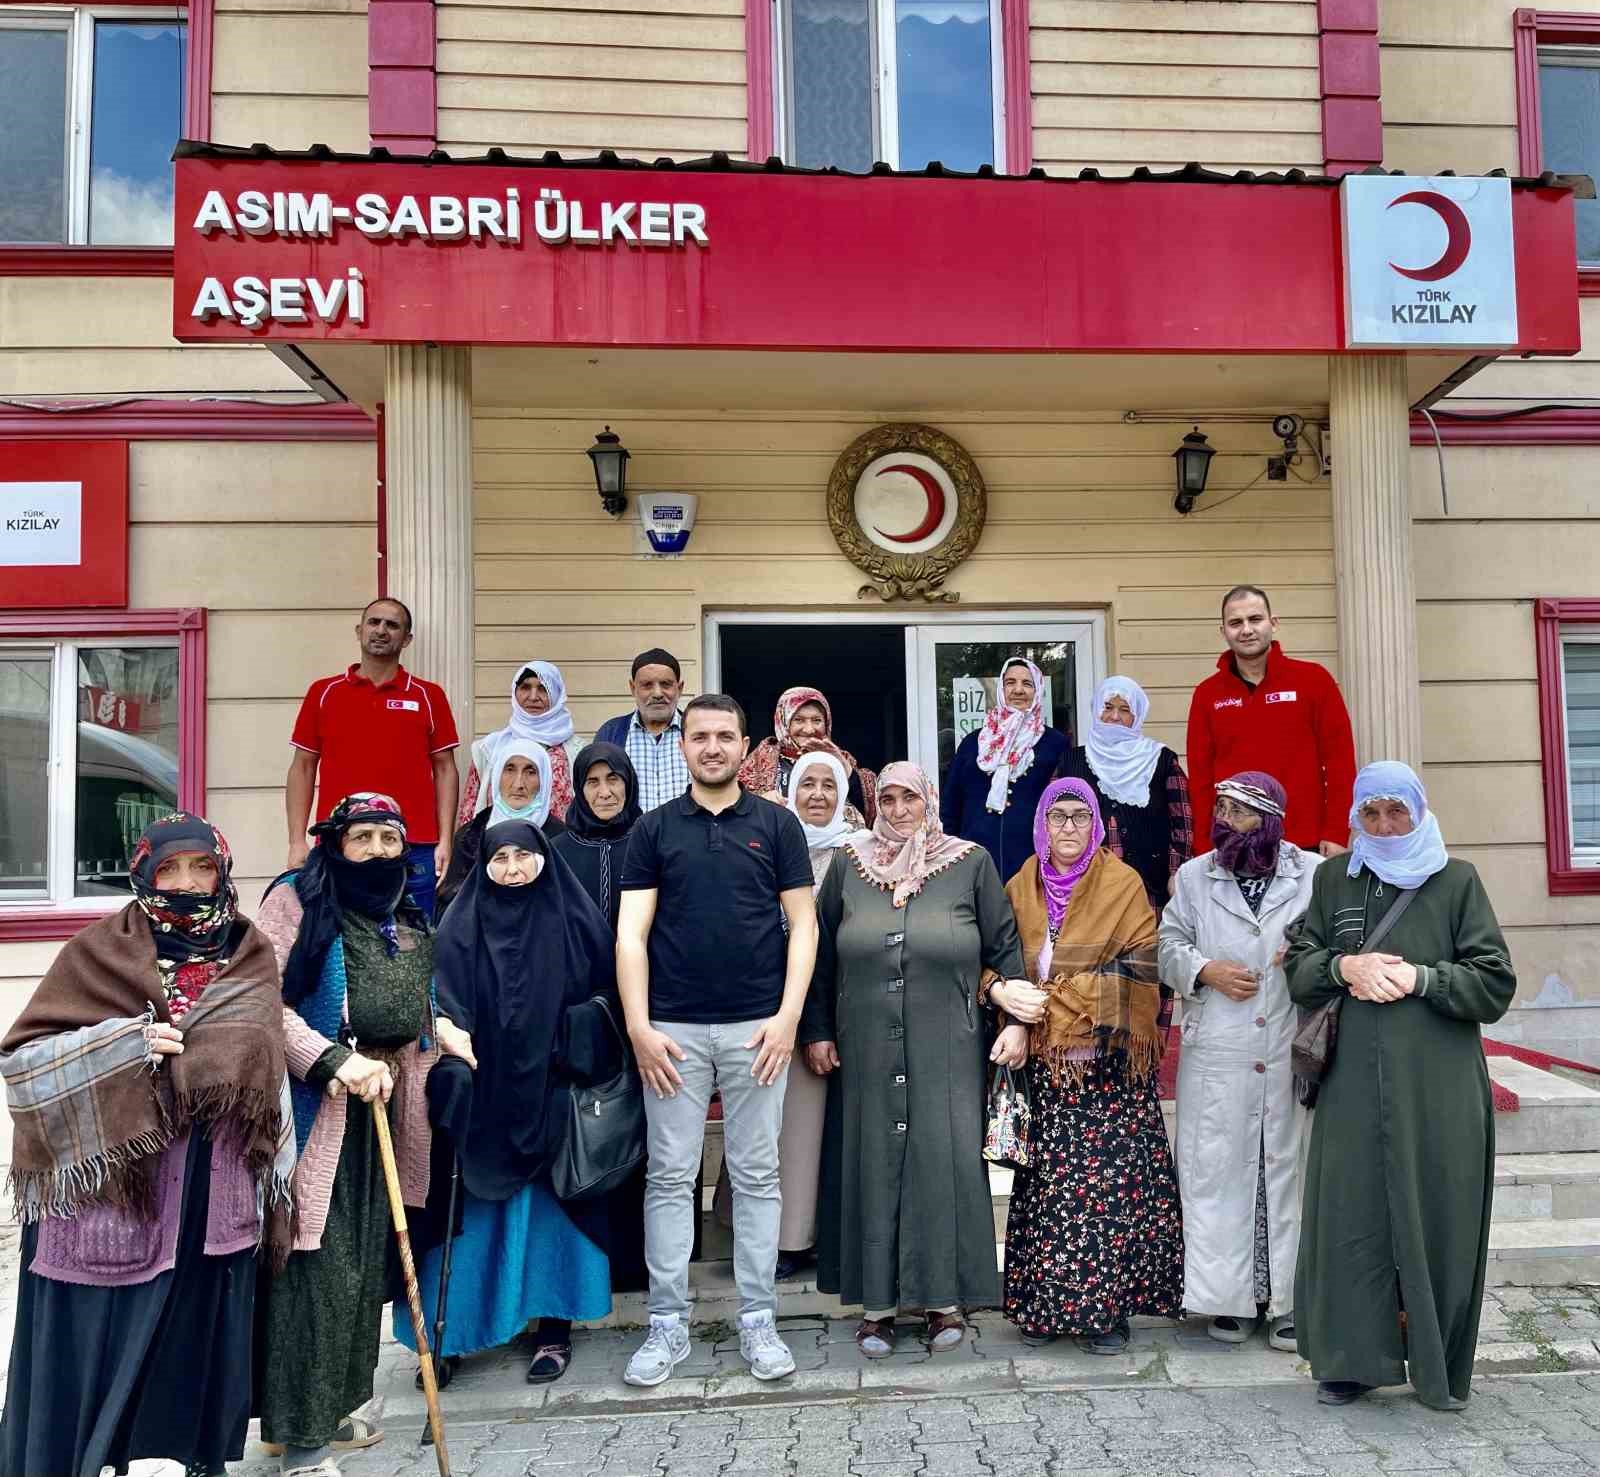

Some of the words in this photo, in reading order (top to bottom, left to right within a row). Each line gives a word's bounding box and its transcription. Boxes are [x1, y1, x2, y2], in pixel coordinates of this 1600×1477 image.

[193, 188, 521, 242] ASIM-SABRİ
[535, 188, 709, 246] ÜLKER
[192, 267, 364, 329] AŞEVİ
[1416, 289, 1451, 302] TÜRK
[1391, 304, 1477, 324] KIZILAY
[23, 509, 45, 518] TÜRK
[6, 518, 60, 531] KIZILAY
